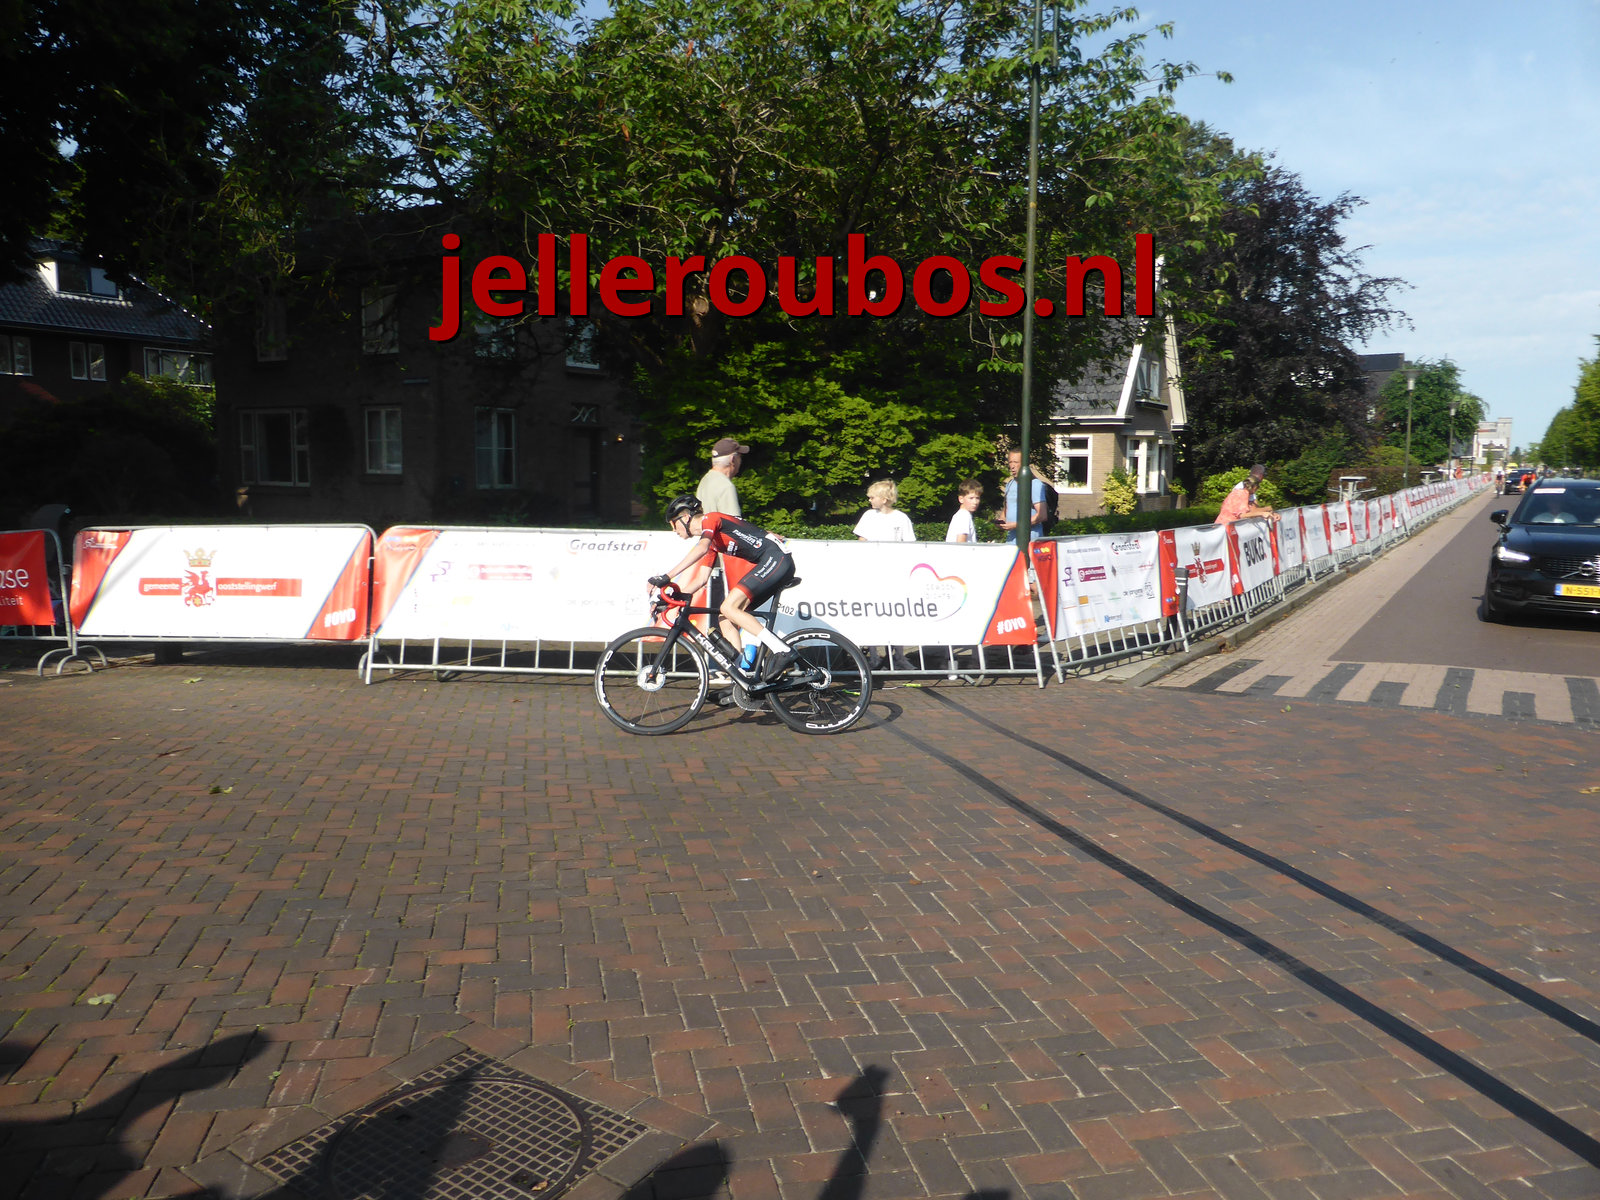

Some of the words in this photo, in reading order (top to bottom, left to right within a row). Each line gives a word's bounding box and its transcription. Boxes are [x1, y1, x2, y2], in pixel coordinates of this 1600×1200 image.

[569, 538, 643, 551] Graafstra
[1243, 537, 1265, 567] BUKO
[1566, 586, 1600, 596] N-551-
[324, 607, 356, 628] #OVO
[996, 616, 1026, 635] #OVO
[695, 633, 732, 670] KRUSH
